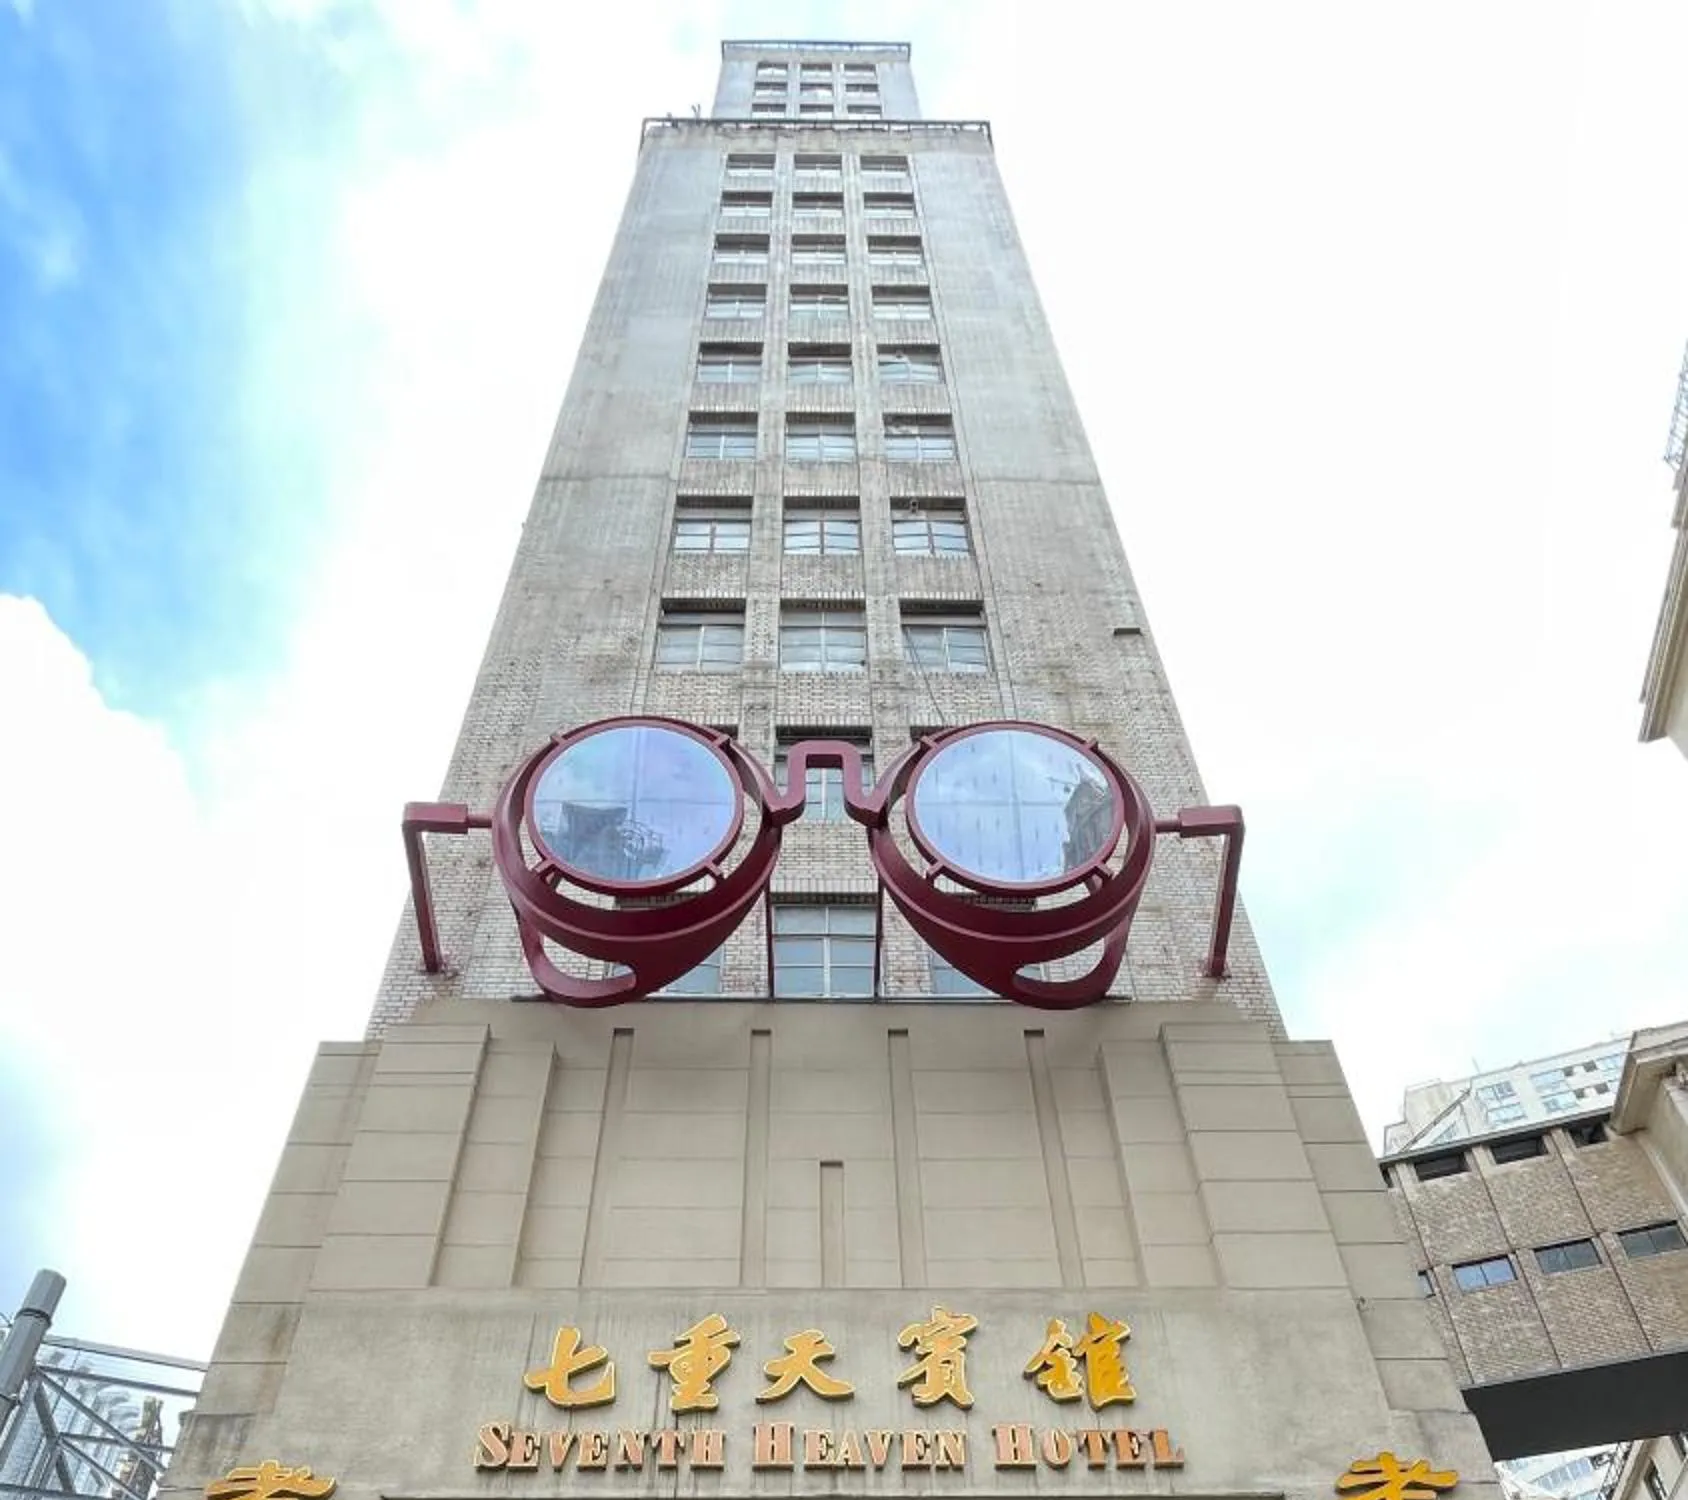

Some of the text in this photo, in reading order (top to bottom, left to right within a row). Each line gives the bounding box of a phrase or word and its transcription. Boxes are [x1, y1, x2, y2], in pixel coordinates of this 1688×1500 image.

[473, 1420, 1185, 1472] SEVENTH HEAVEN HOTEL
